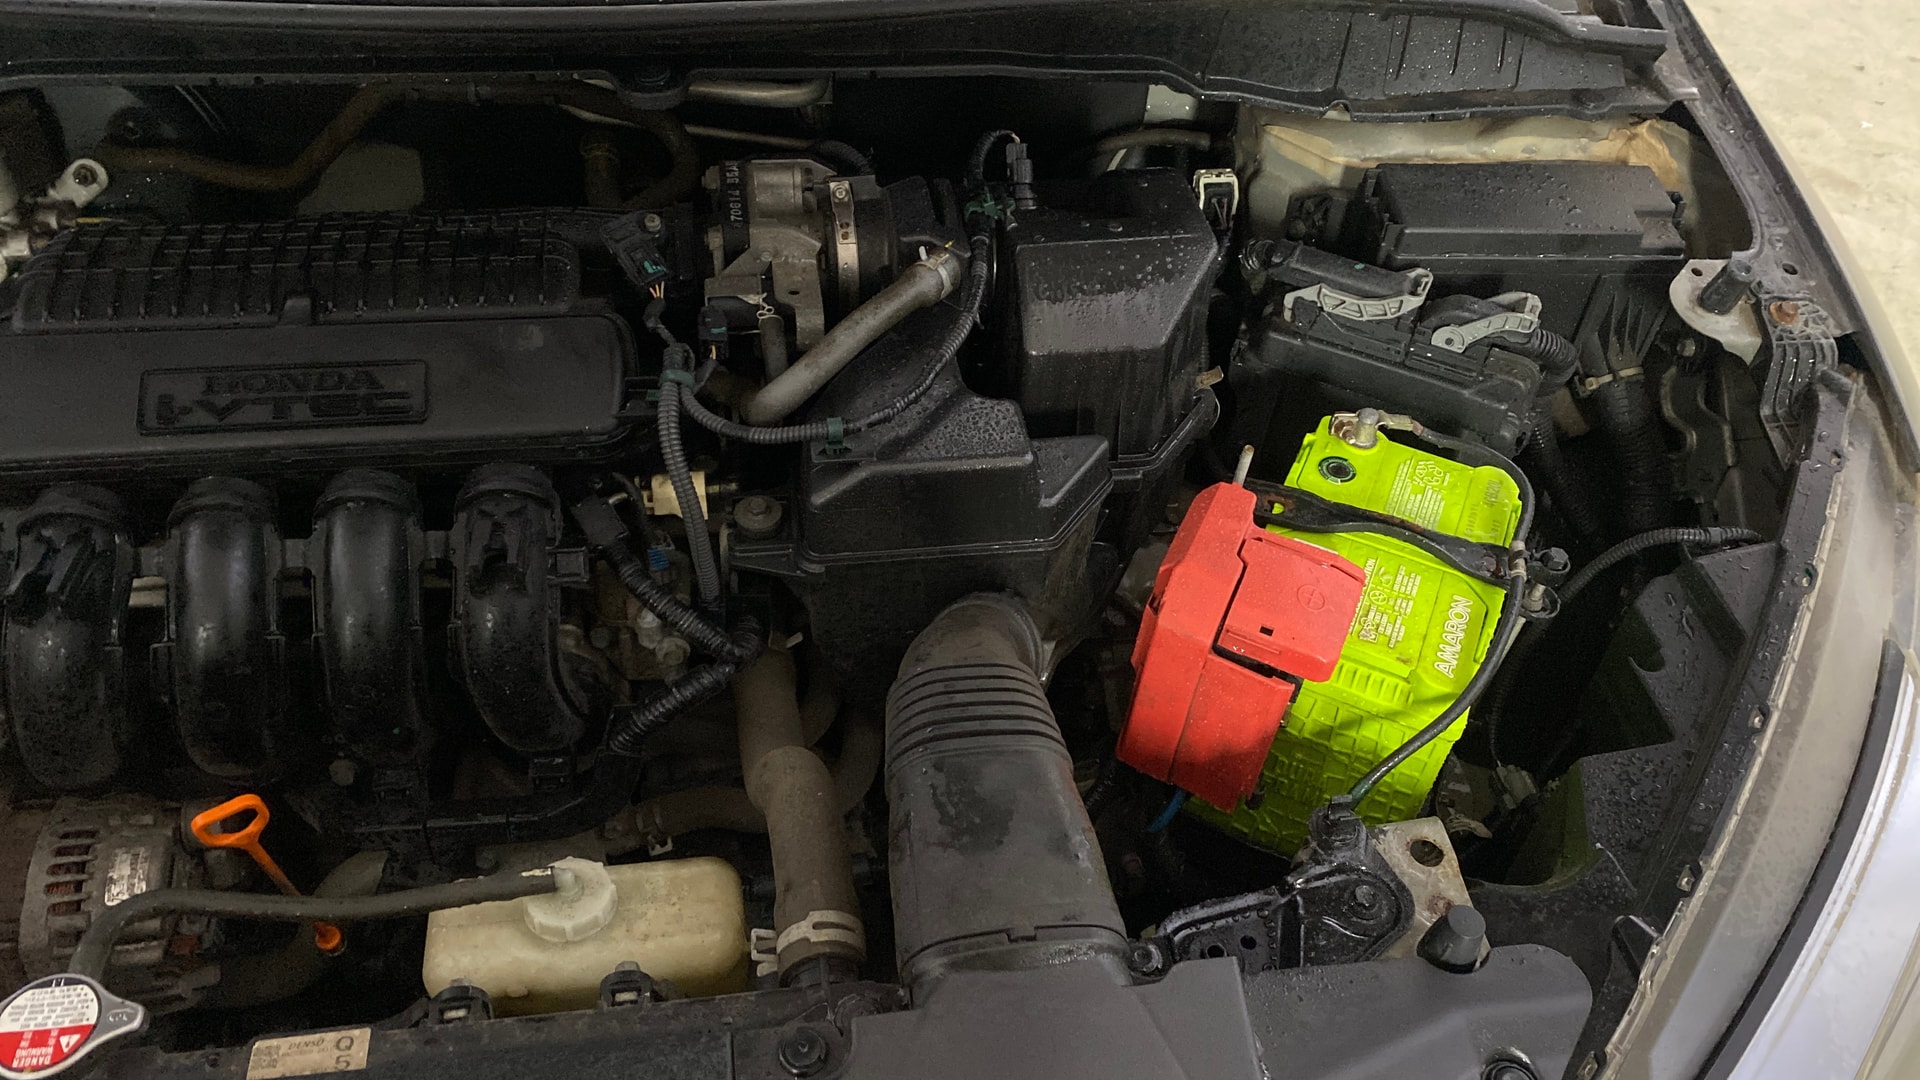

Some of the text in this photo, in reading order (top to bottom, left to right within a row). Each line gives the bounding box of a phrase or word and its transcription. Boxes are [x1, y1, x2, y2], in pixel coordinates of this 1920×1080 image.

[202, 370, 384, 394] HONDA
[1434, 595, 1473, 678] AMARON
[335, 1036, 354, 1051] Q
[12, 1055, 51, 1068] DANGER
